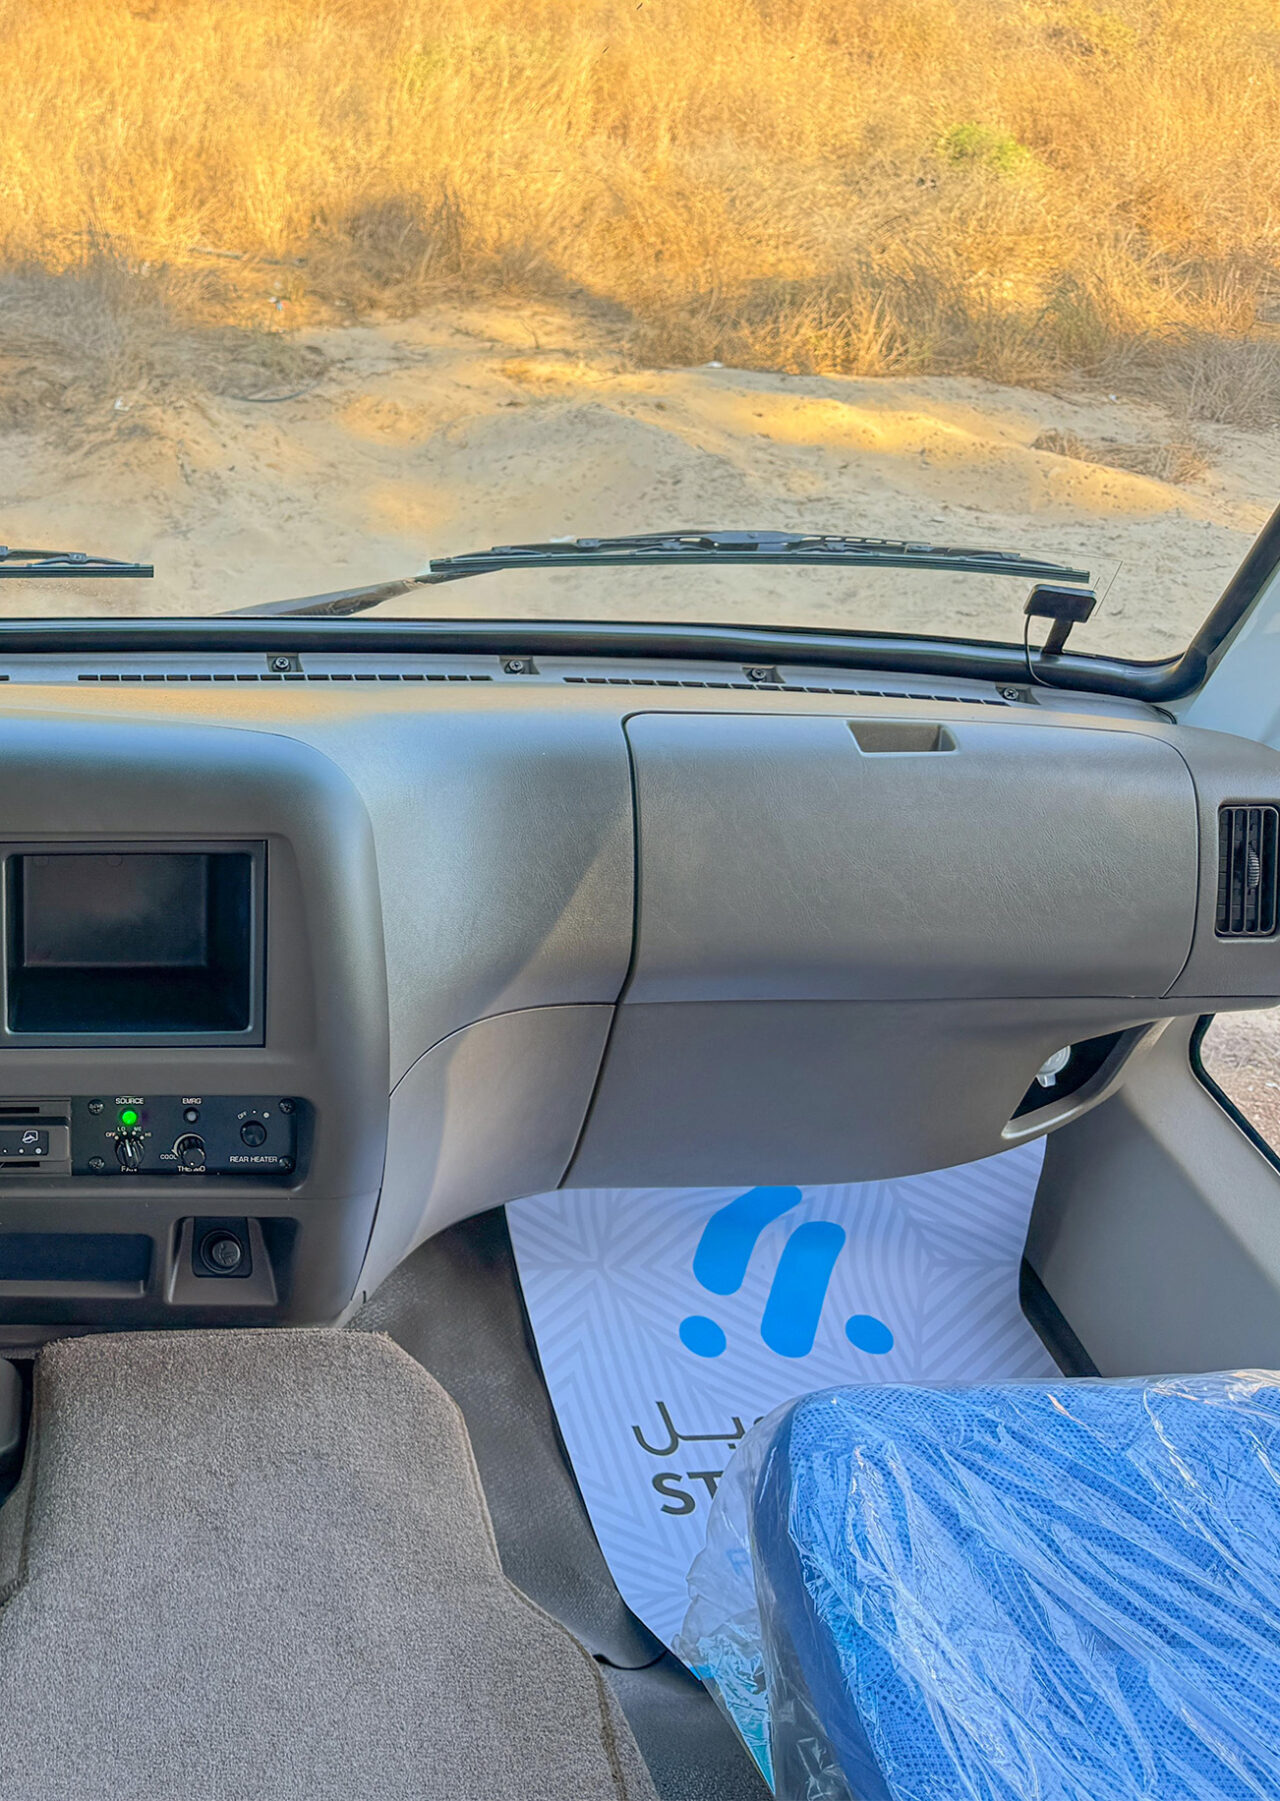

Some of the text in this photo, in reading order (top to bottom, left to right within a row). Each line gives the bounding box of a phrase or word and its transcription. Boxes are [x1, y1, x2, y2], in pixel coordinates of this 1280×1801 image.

[115, 1097, 144, 1105] SOURCE
[229, 1155, 278, 1163] REAR HEATER
